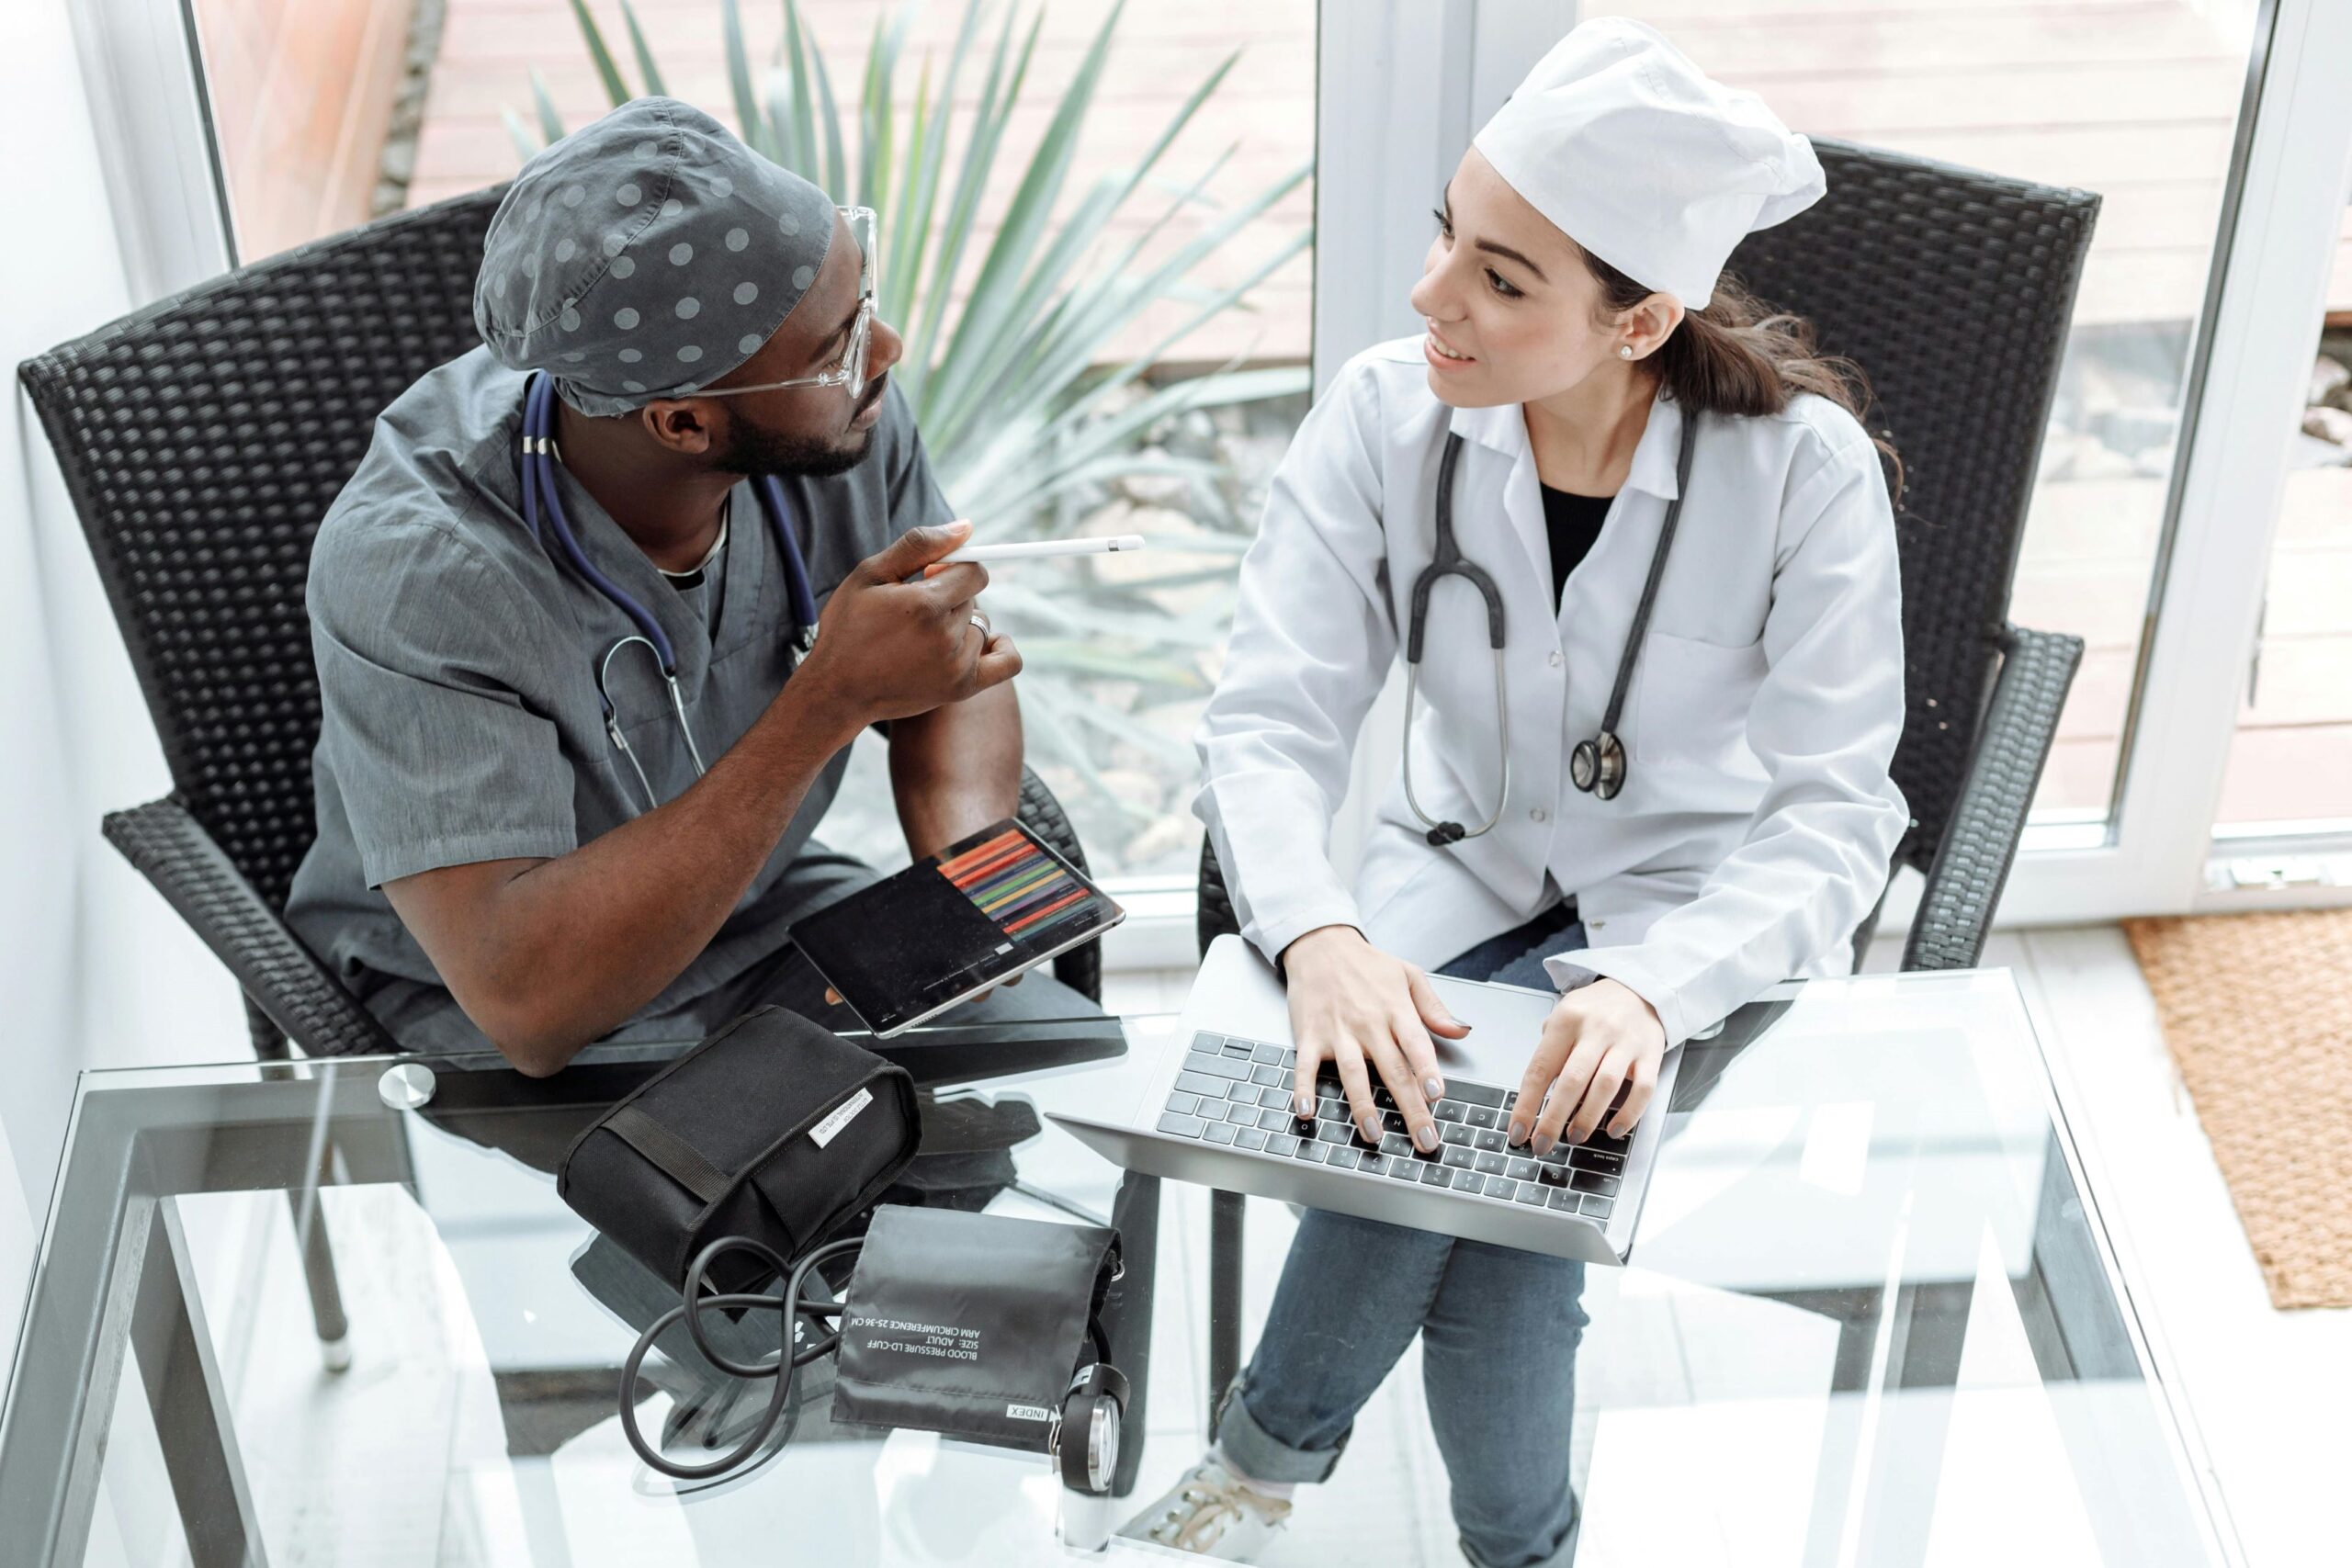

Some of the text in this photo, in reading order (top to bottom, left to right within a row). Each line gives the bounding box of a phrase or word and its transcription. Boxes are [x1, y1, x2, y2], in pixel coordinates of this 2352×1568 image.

[851, 1317, 980, 1338] ARM CIRCUMFERENCE 25-36 CM
[867, 1340, 977, 1360] BLOOD PRESSURE LD-CUFF
[926, 1336, 978, 1350] SIZE: ADULT
[1012, 1407, 1044, 1418] INDEX
